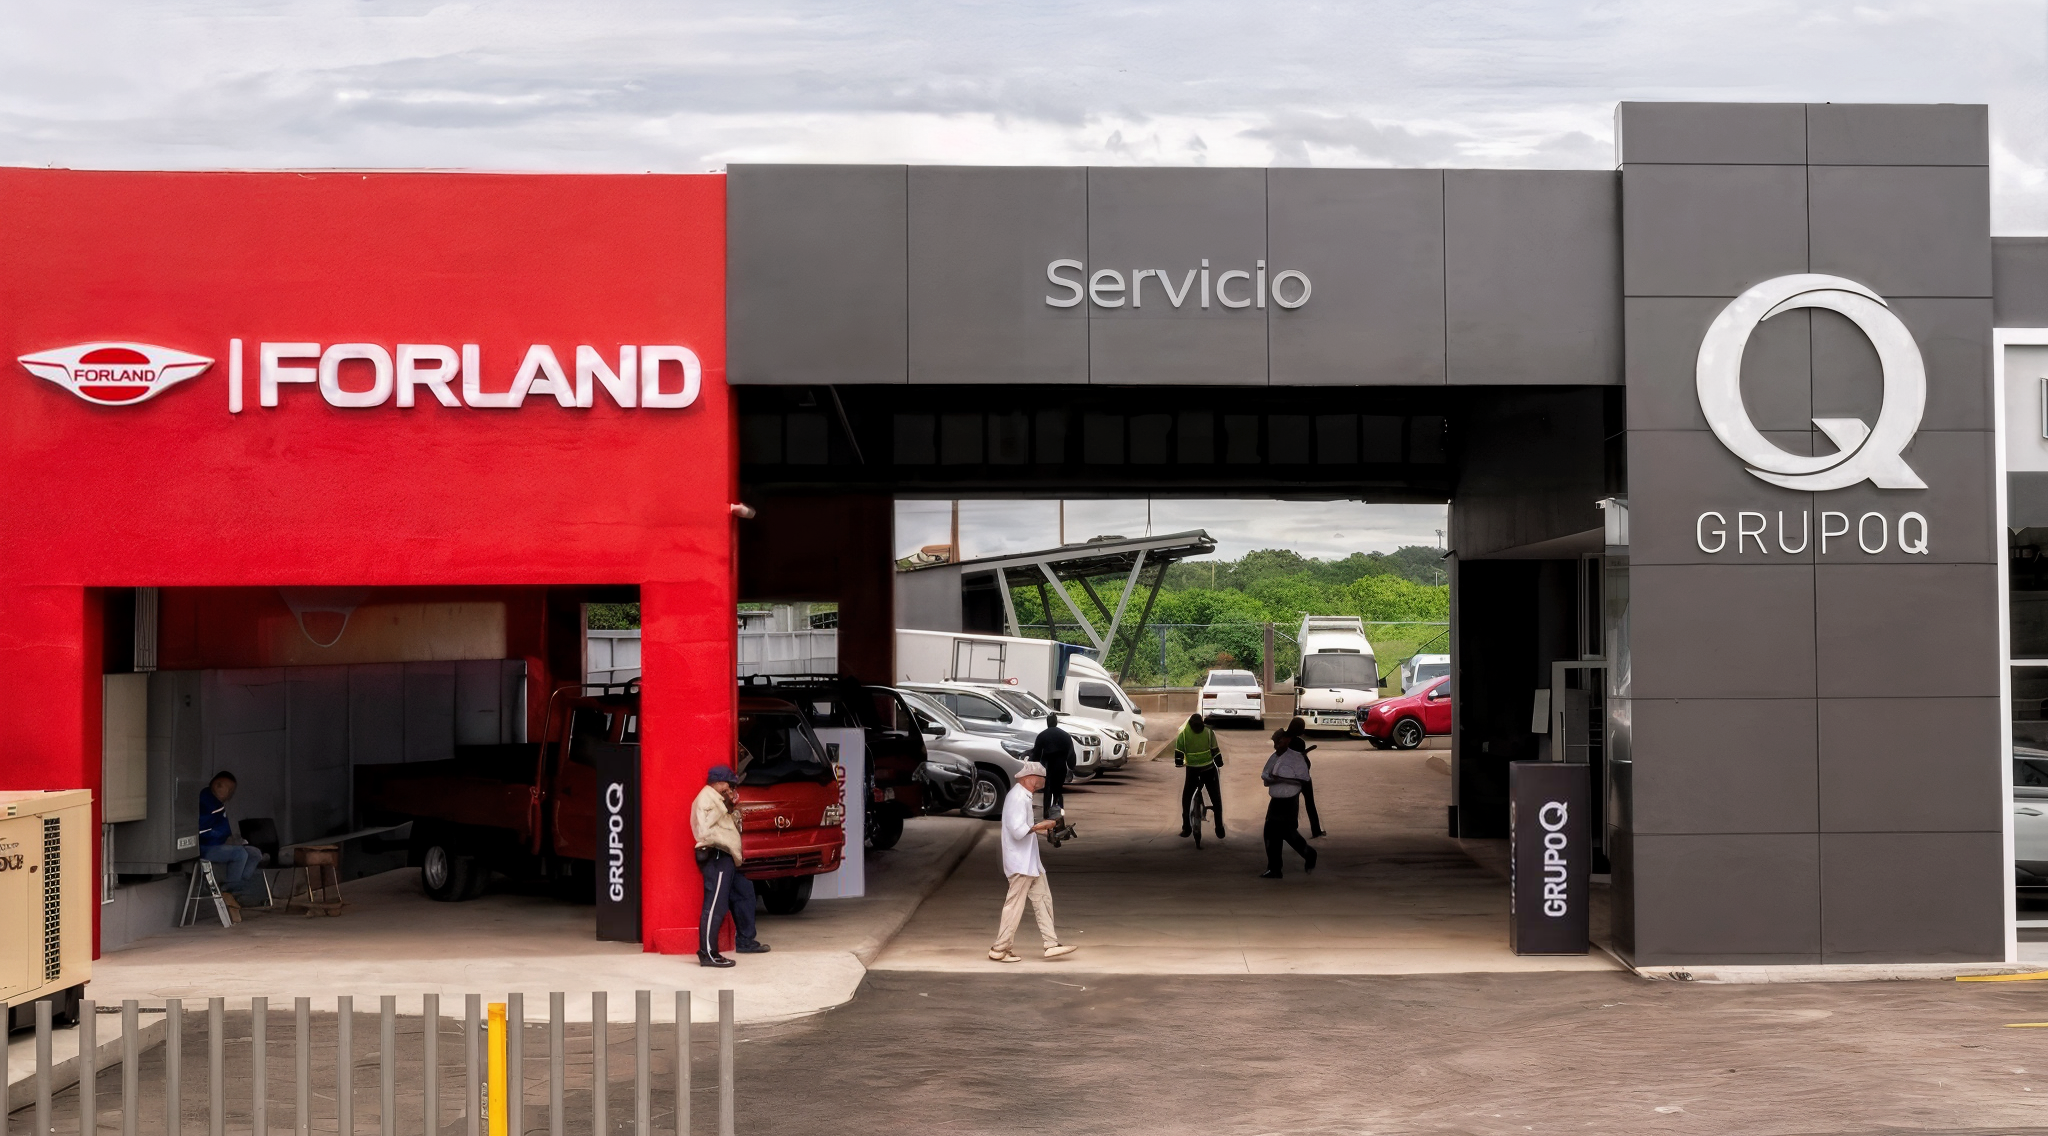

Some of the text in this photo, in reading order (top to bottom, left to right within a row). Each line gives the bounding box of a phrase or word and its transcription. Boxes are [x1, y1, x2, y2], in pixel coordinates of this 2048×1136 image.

[1045, 258, 1312, 309] Servicio
[74, 369, 156, 382] FORLAND
[260, 342, 702, 408] FORLAND
[1696, 273, 1929, 491] Q
[1696, 511, 1929, 555] GRUPOQ
[606, 782, 624, 902] GRUPOQ
[1538, 801, 1568, 917] GRUPOQ
